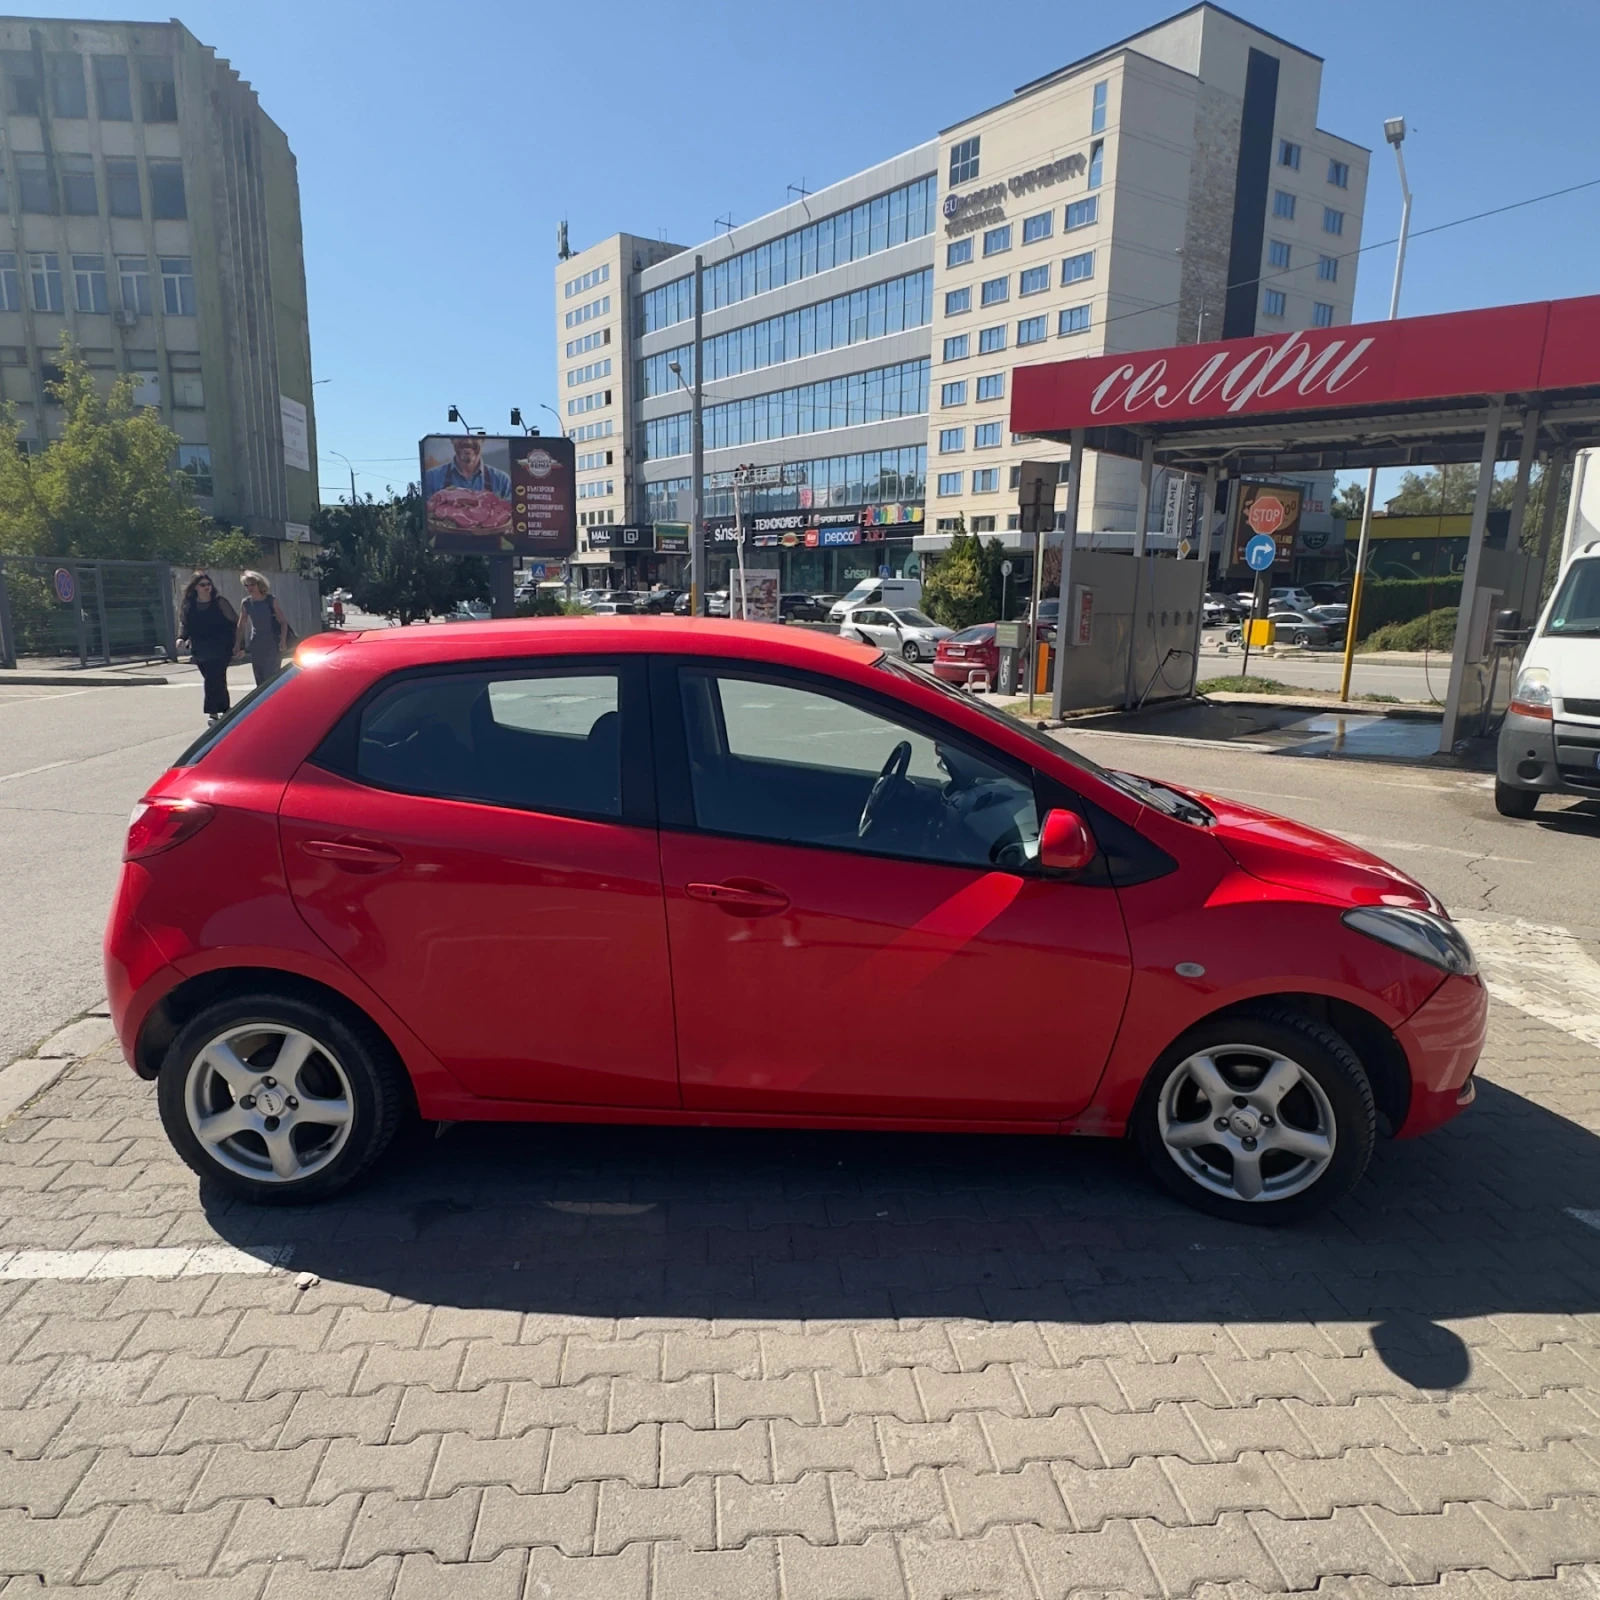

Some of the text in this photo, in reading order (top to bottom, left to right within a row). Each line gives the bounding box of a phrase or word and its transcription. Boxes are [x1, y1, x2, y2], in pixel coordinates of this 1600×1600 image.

[1089, 331, 1376, 415] селфи
[1166, 483, 1178, 535] SESAME
[1252, 509, 1281, 522] STOP
[591, 530, 611, 541] MALL
[714, 524, 746, 545] sinsay
[824, 531, 855, 544] pepco
